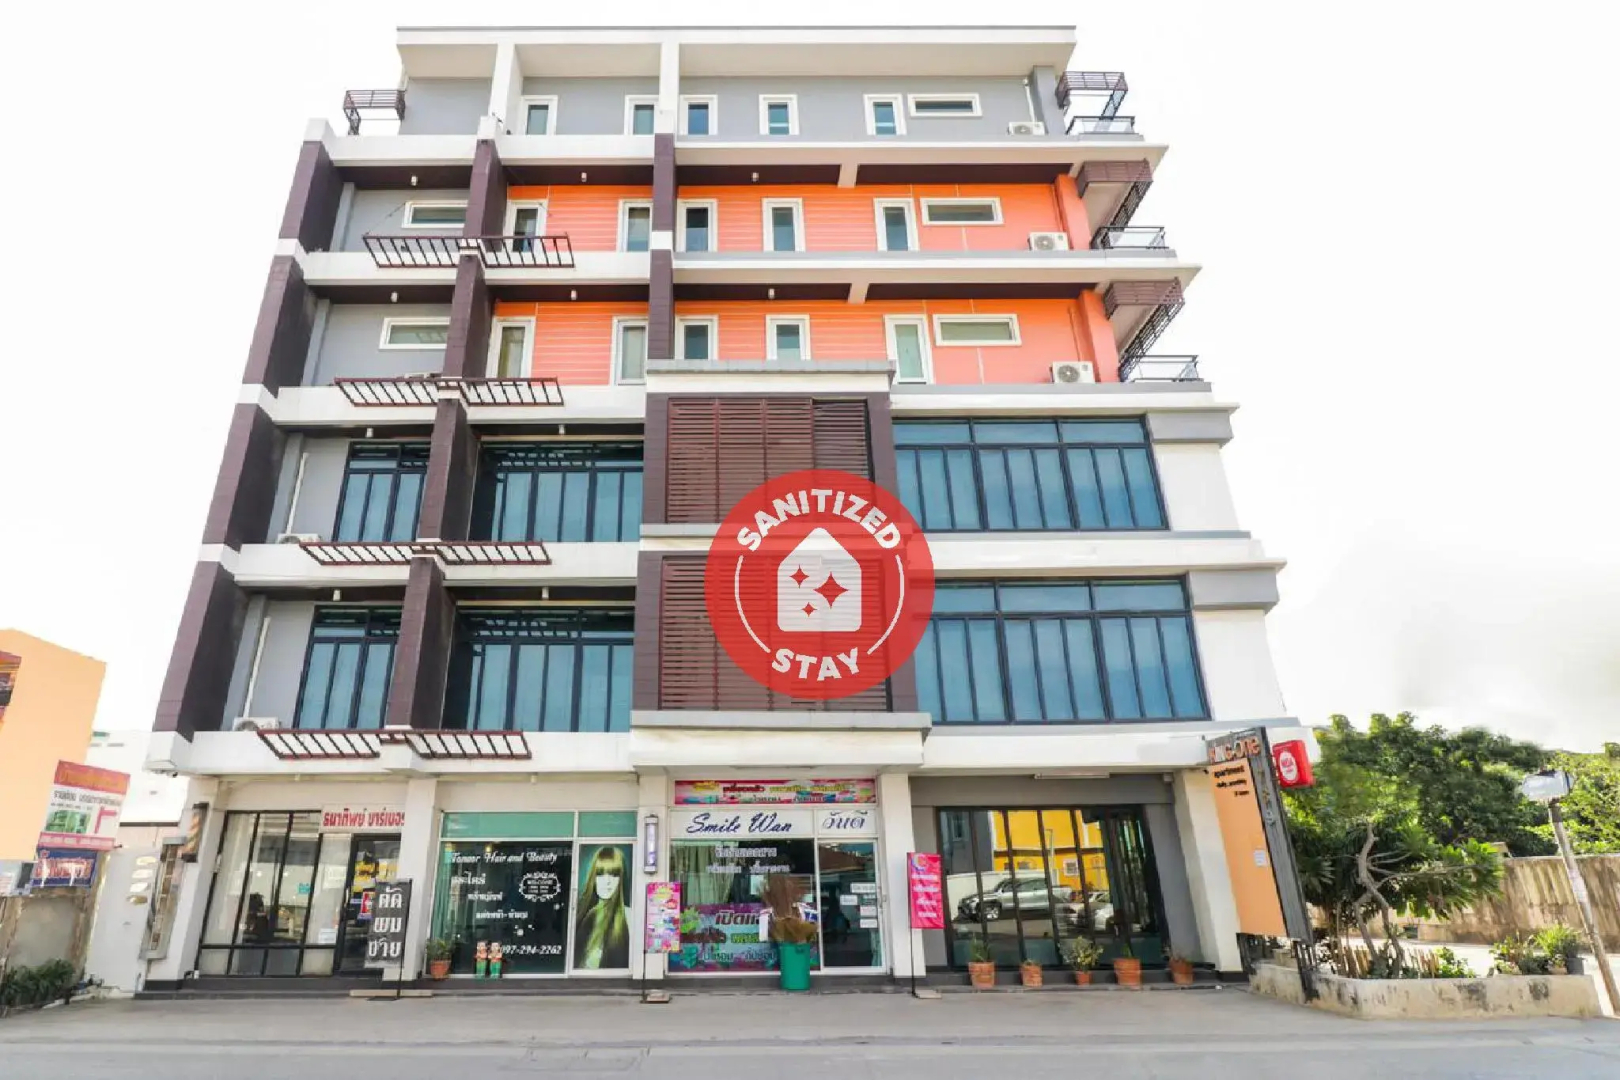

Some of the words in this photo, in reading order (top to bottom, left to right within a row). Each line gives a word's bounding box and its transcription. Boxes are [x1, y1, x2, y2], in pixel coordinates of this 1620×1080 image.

[686, 812, 741, 834] Smile
[748, 812, 792, 833] Wan
[822, 809, 869, 830] วันดี
[484, 850, 506, 863] Hair
[507, 852, 524, 862] and
[526, 851, 558, 865] Beauty
